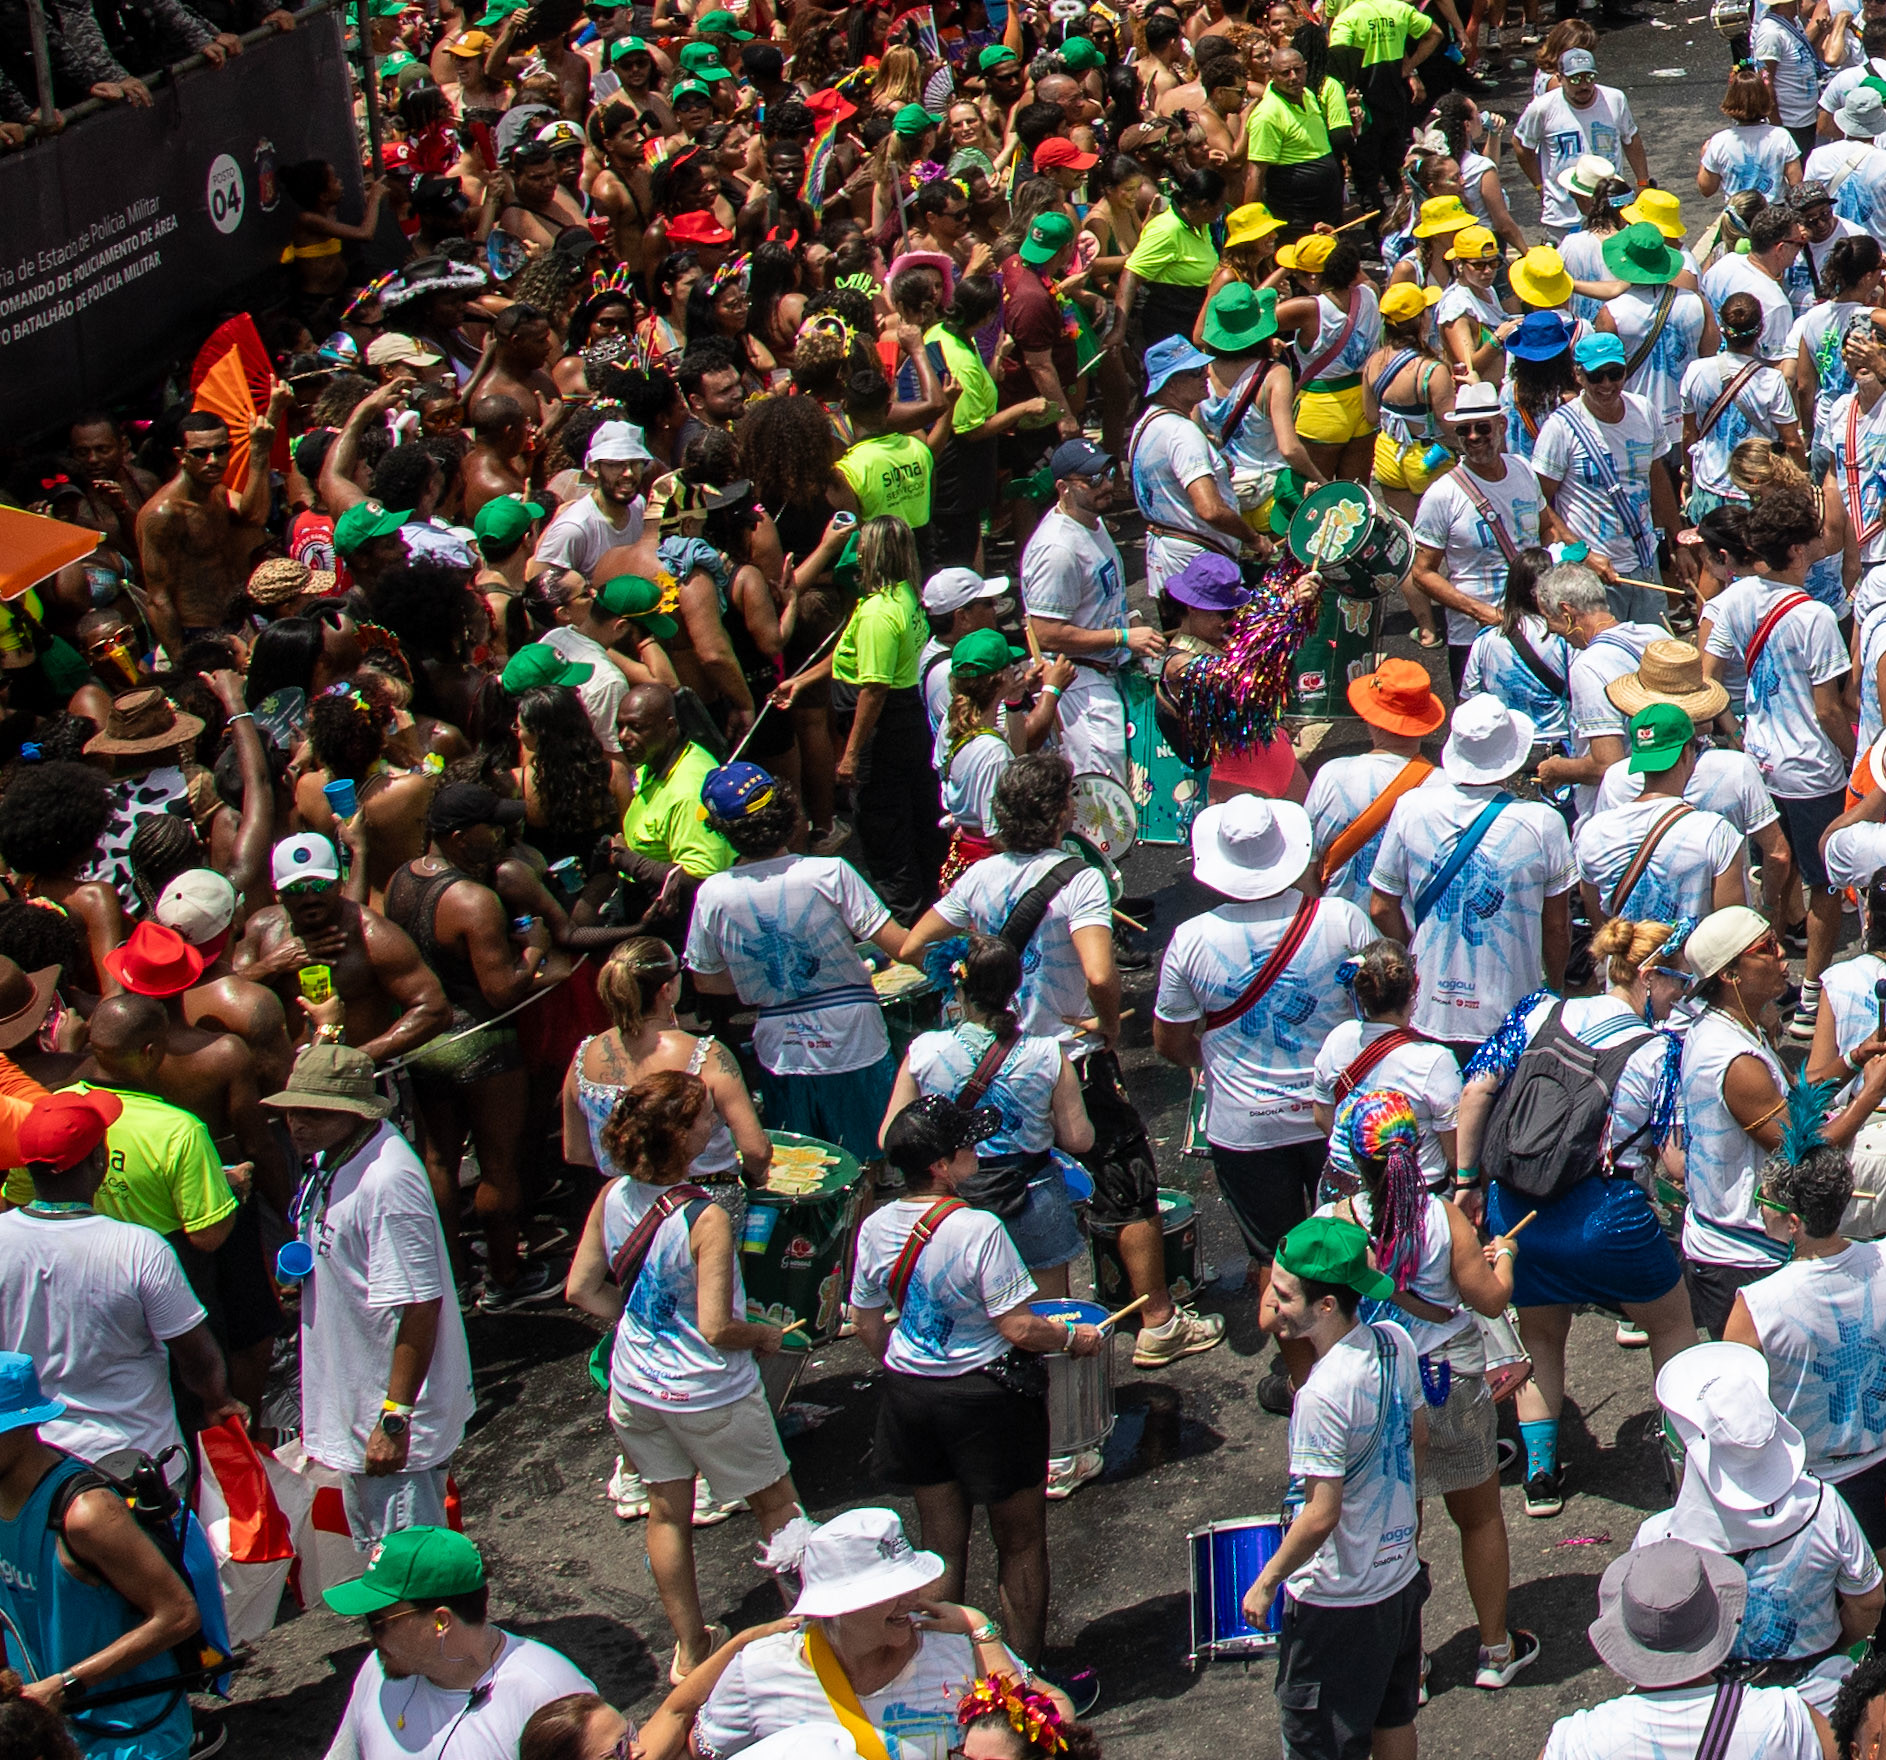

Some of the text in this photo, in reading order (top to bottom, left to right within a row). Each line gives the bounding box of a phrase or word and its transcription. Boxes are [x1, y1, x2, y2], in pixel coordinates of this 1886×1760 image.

[213, 168, 235, 185] POSTO
[213, 182, 241, 221] 04
[18, 258, 35, 281] de
[38, 240, 78, 272] Estado
[78, 231, 91, 251] de
[90, 212, 127, 244] Polícia
[128, 194, 160, 226] Militar
[57, 272, 72, 292] DE
[74, 236, 139, 285] POLICIAMENTO
[140, 228, 152, 249] DE
[154, 214, 179, 242] ÁREA
[14, 250, 162, 340] BATALHÃO DE POLÍCIA MILITAR
[882, 462, 922, 488] sigma
